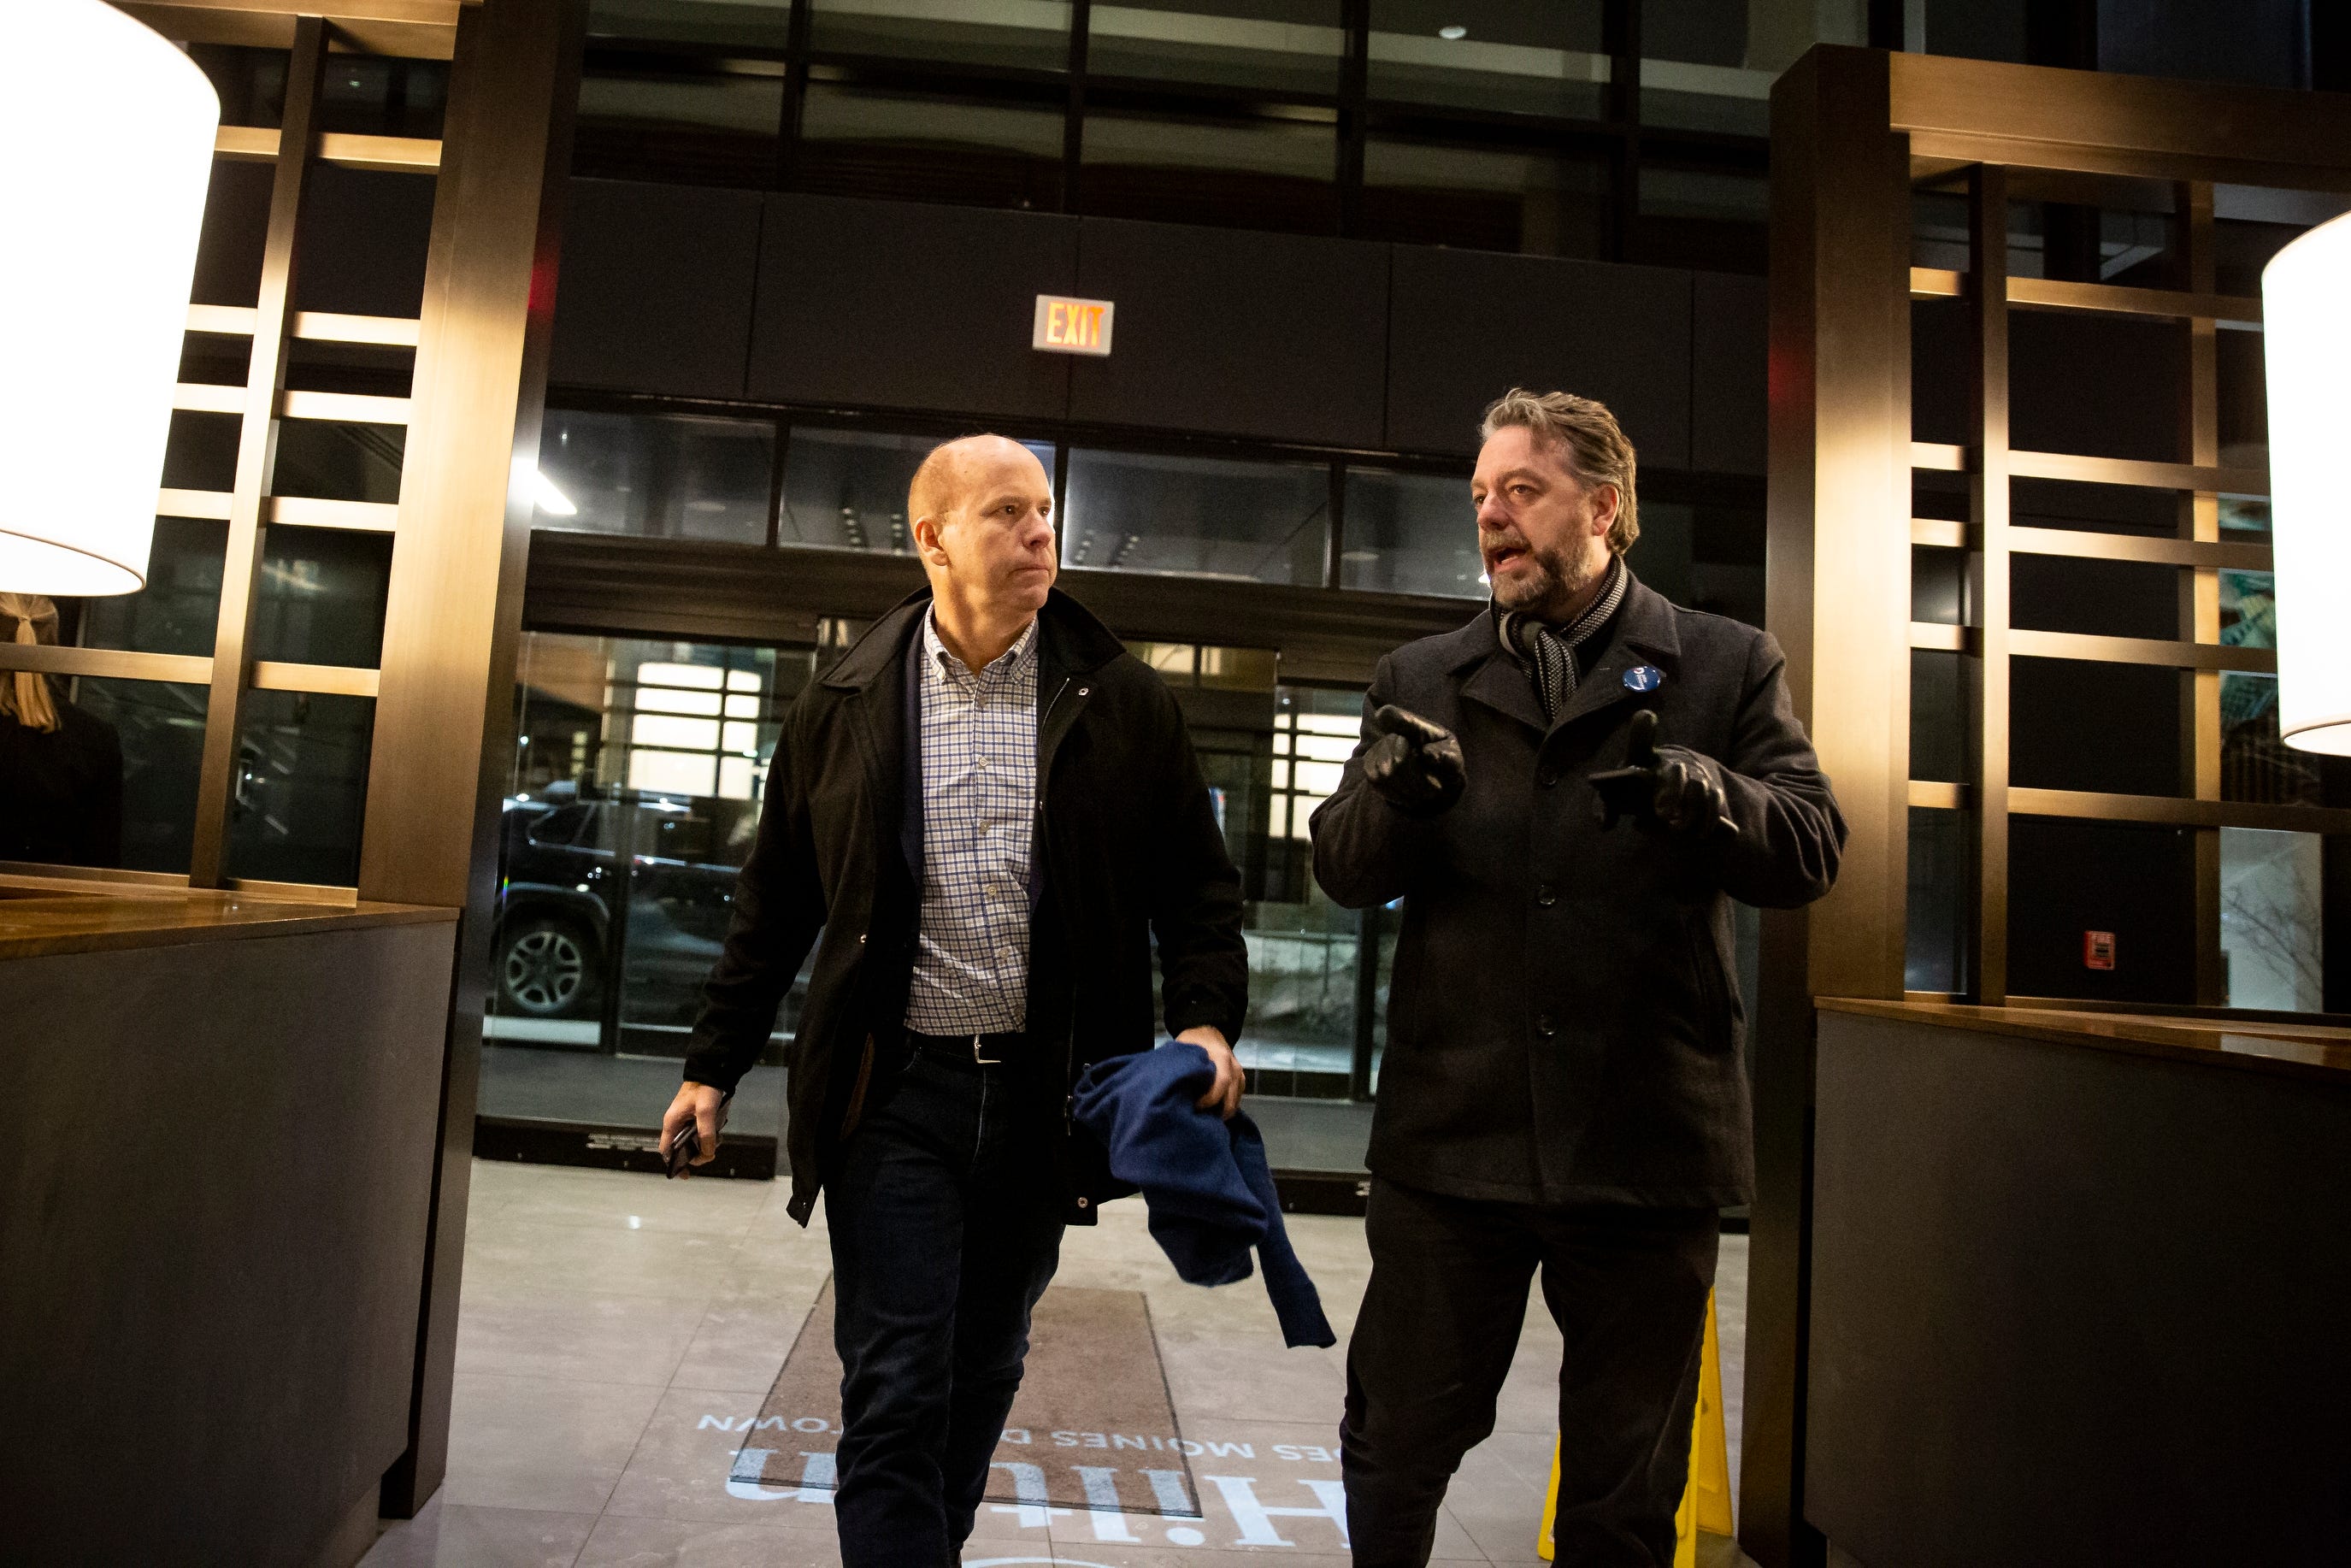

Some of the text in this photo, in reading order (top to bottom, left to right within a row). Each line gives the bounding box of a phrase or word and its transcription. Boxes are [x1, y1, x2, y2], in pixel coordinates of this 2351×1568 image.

[1046, 301, 1105, 346] EXIT
[1051, 1429, 1256, 1459] MOINES
[725, 1448, 1351, 1549] Hiltn
